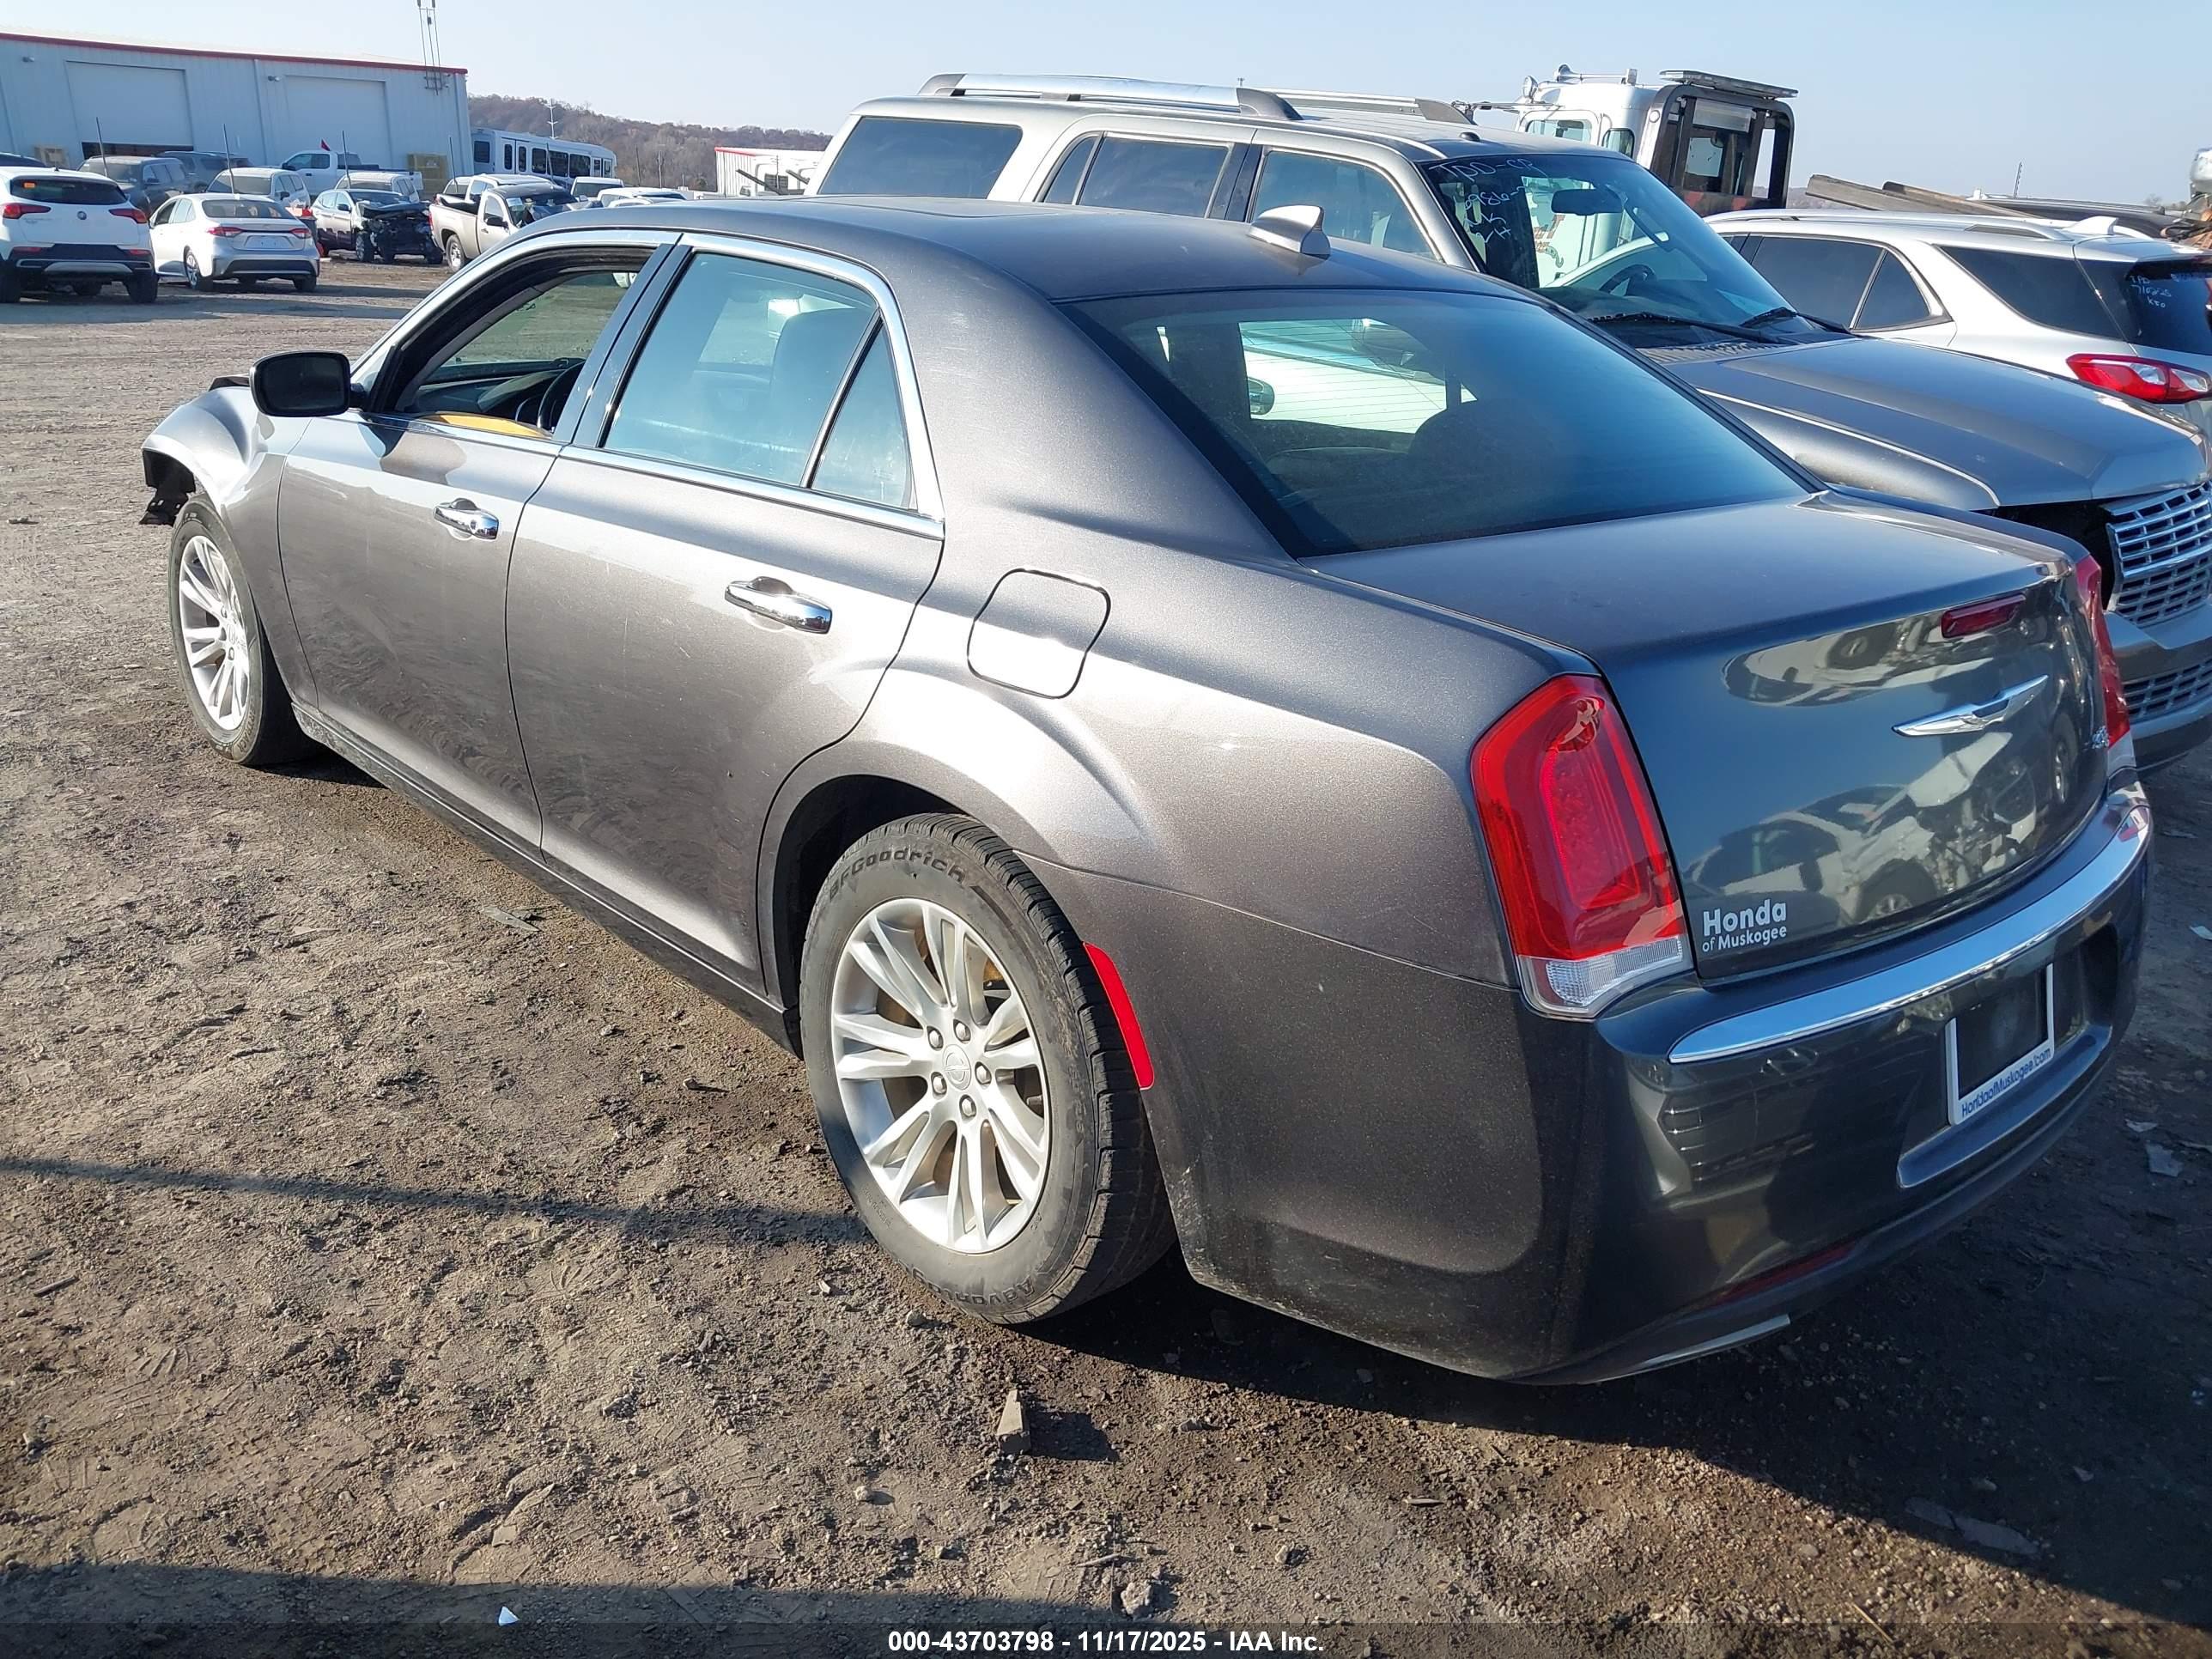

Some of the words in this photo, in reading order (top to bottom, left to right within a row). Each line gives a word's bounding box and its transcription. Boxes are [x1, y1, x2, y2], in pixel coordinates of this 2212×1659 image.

[830, 846, 967, 902] BFGoodrich
[1703, 898, 1787, 937] Honda
[1702, 936, 1717, 952] of
[1717, 925, 1787, 951] Muskogee
